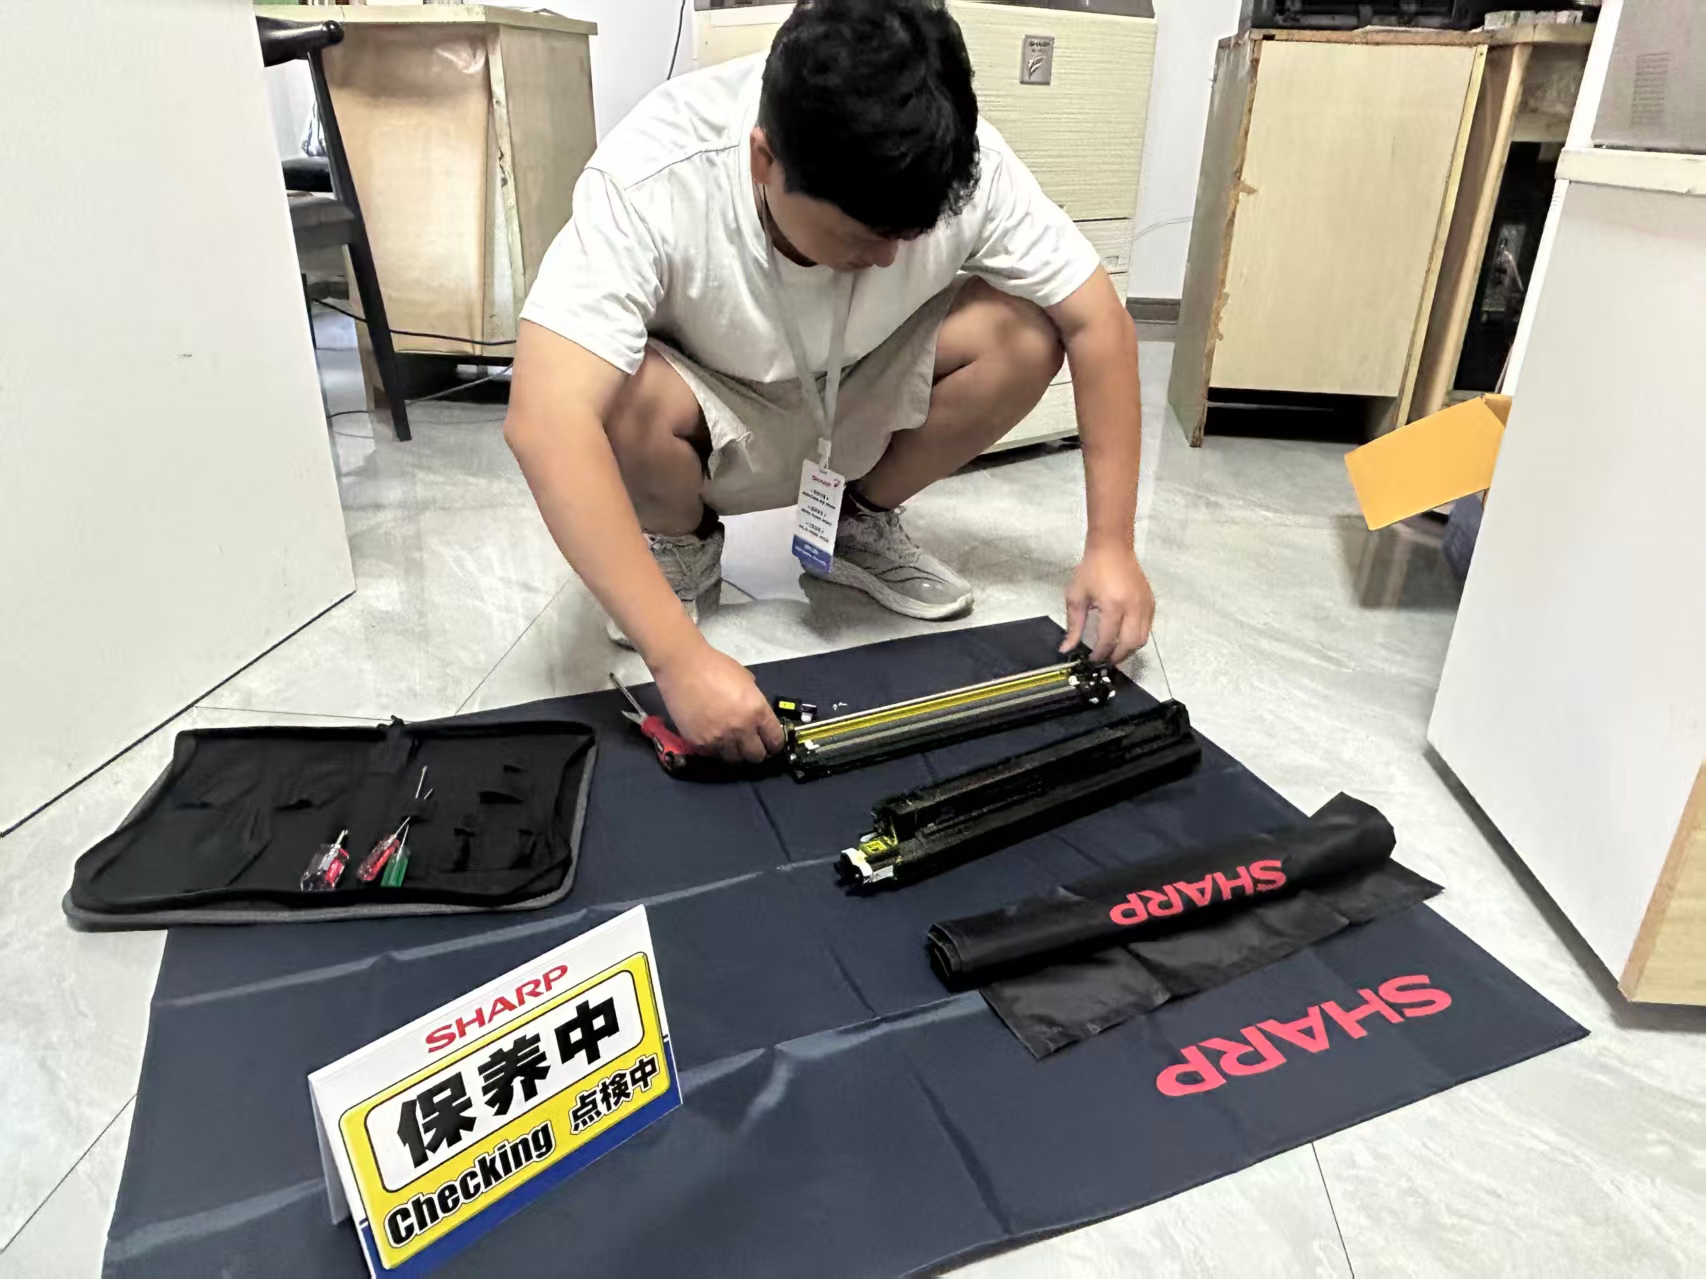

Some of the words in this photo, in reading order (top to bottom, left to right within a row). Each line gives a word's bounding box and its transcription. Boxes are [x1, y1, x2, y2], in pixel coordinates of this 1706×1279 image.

[1109, 859, 1286, 925] SHARP
[425, 965, 568, 1053] SHARP
[1156, 974, 1452, 1097] SHARP
[397, 996, 620, 1168] 保养中
[571, 1057, 658, 1132] 点検中
[388, 1124, 553, 1245] Checking
